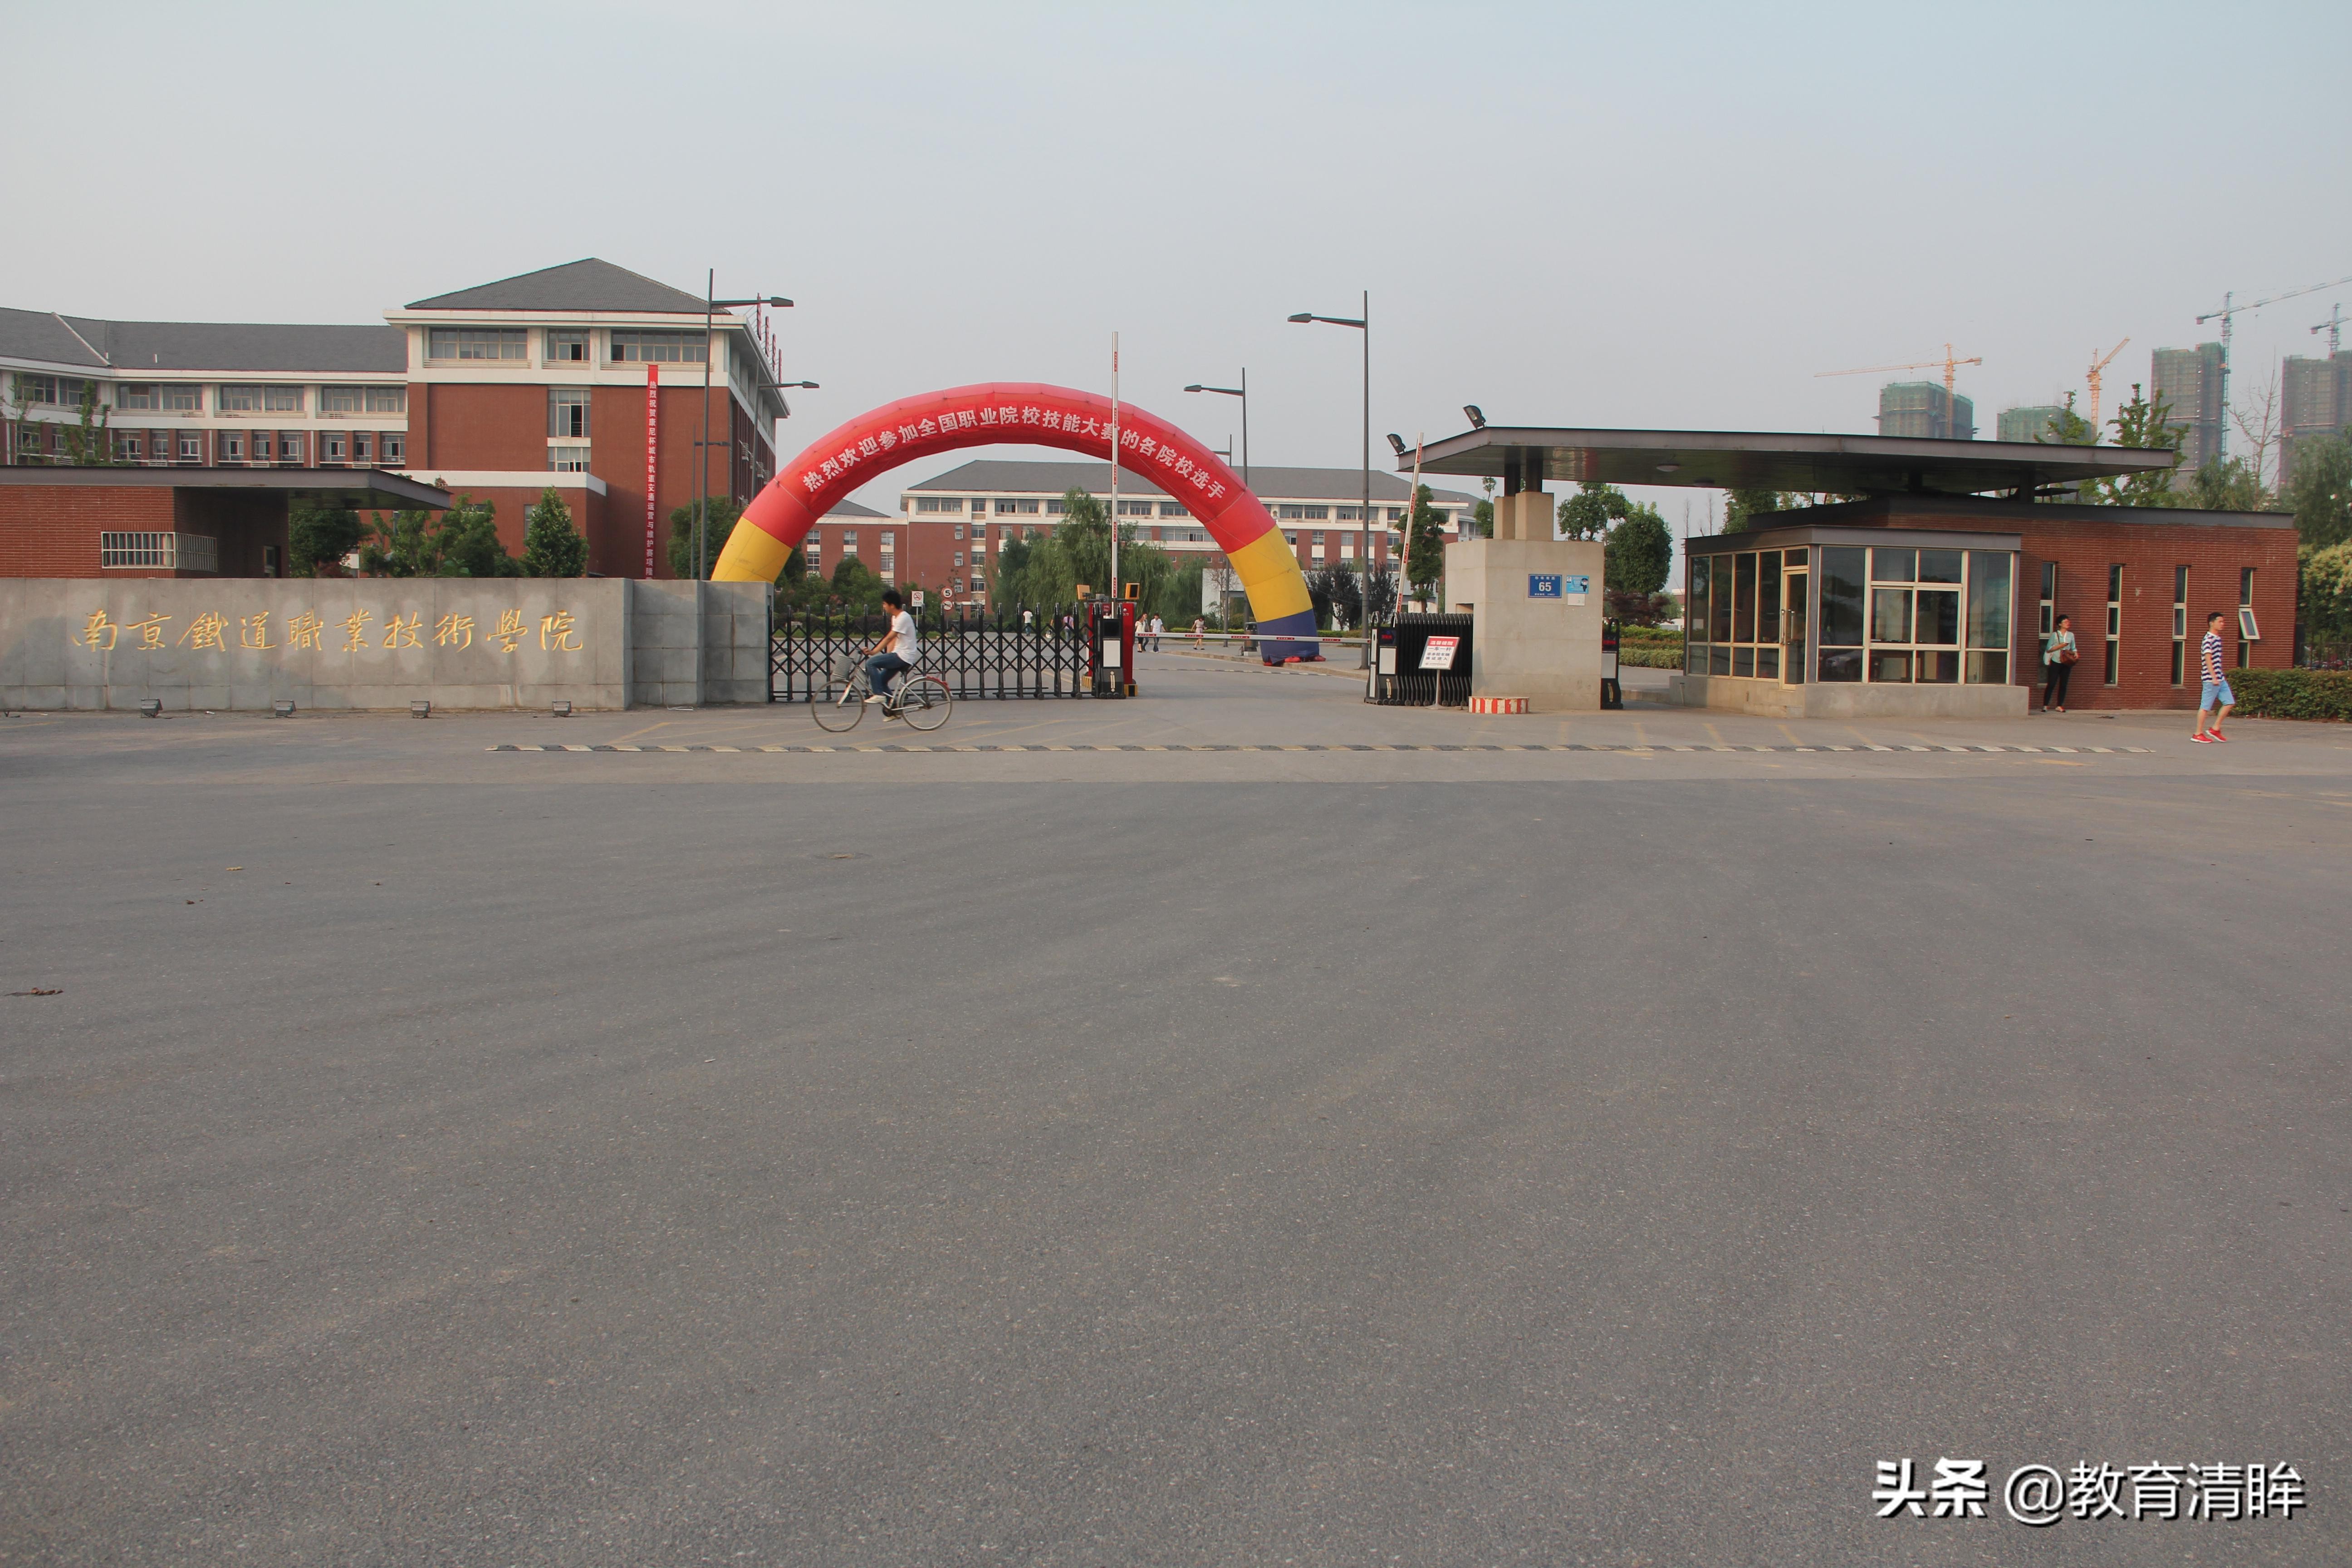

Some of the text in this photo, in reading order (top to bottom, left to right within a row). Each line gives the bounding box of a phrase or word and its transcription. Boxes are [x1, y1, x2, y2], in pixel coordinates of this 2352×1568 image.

[802, 406, 1226, 500] 热烈欢迎参加全国职业院校技能大赛的各院校选手
[1539, 582, 1552, 592] 65
